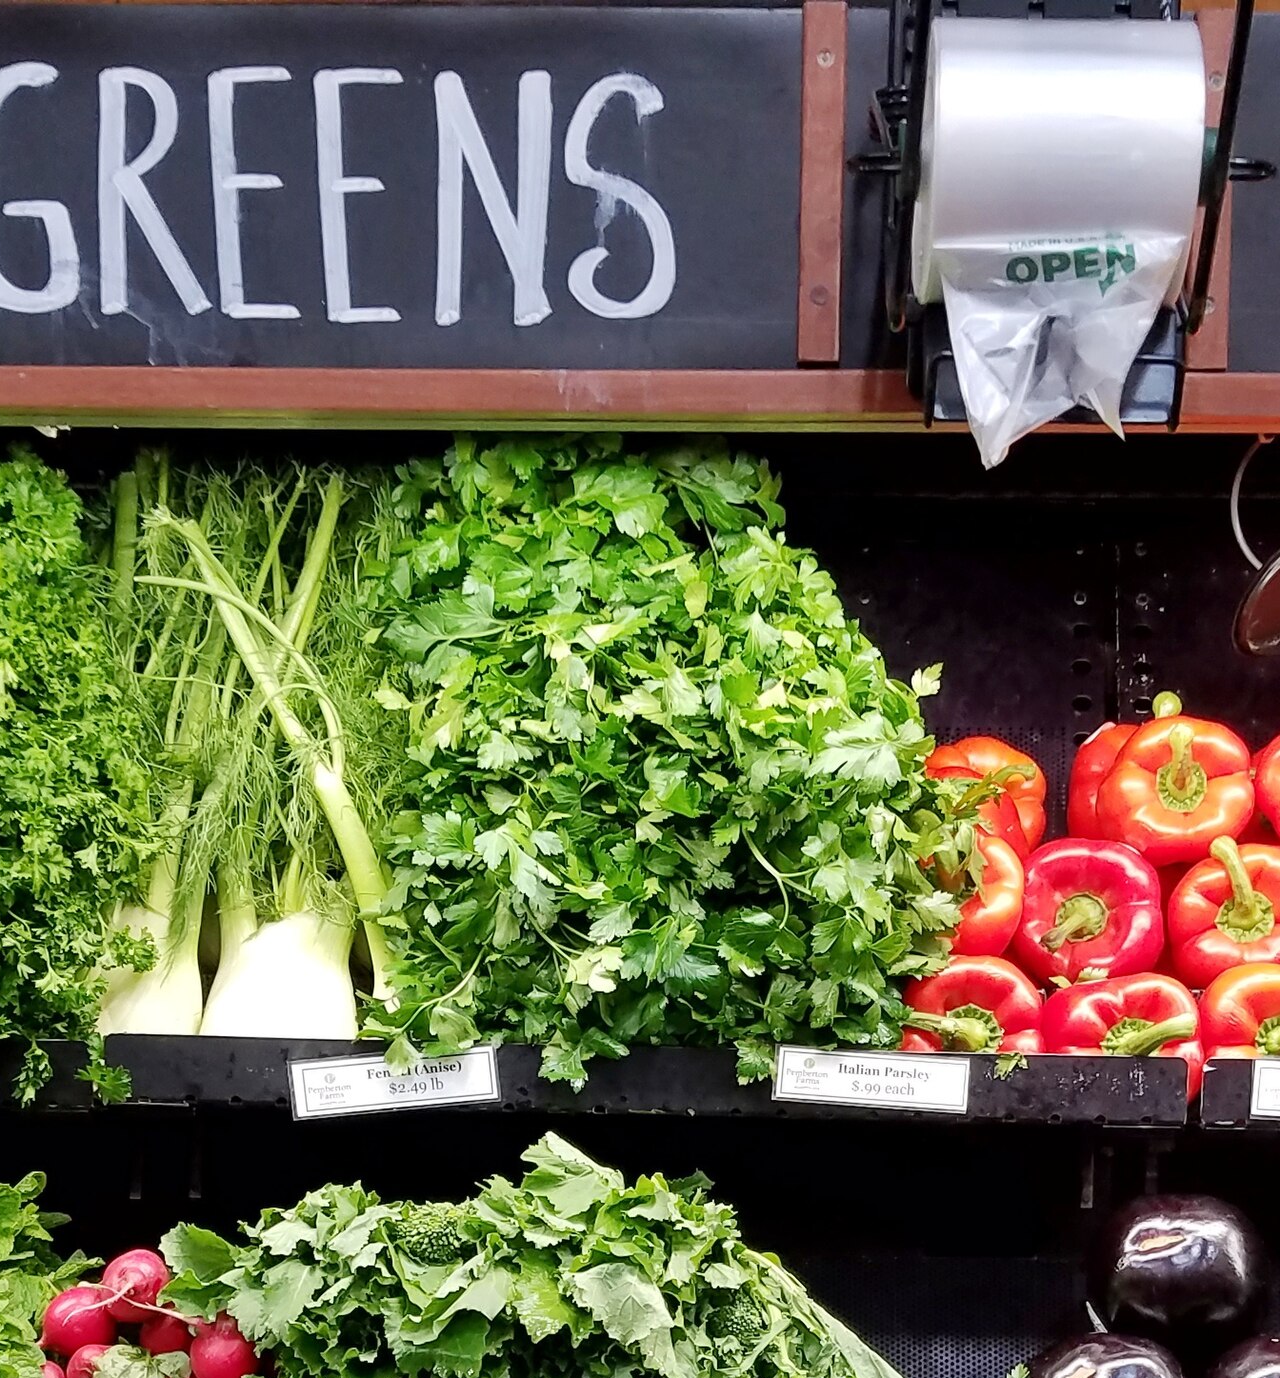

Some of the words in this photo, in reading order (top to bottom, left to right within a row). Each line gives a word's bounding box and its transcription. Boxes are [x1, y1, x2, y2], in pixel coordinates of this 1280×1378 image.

[1005, 243, 1137, 284] OPEN
[367, 1067, 412, 1080] Fenl
[415, 1060, 462, 1077] (Anise)
[786, 1068, 828, 1079] Pemberton
[838, 1063, 880, 1076] Italian
[884, 1066, 931, 1082] Parsley
[307, 1083, 352, 1094] Pemberton
[389, 1081, 427, 1095] $2.49
[431, 1077, 444, 1091] lb
[795, 1076, 820, 1085] Farms
[851, 1080, 880, 1094] $.99
[884, 1082, 915, 1096] each
[319, 1091, 345, 1100] Farms
